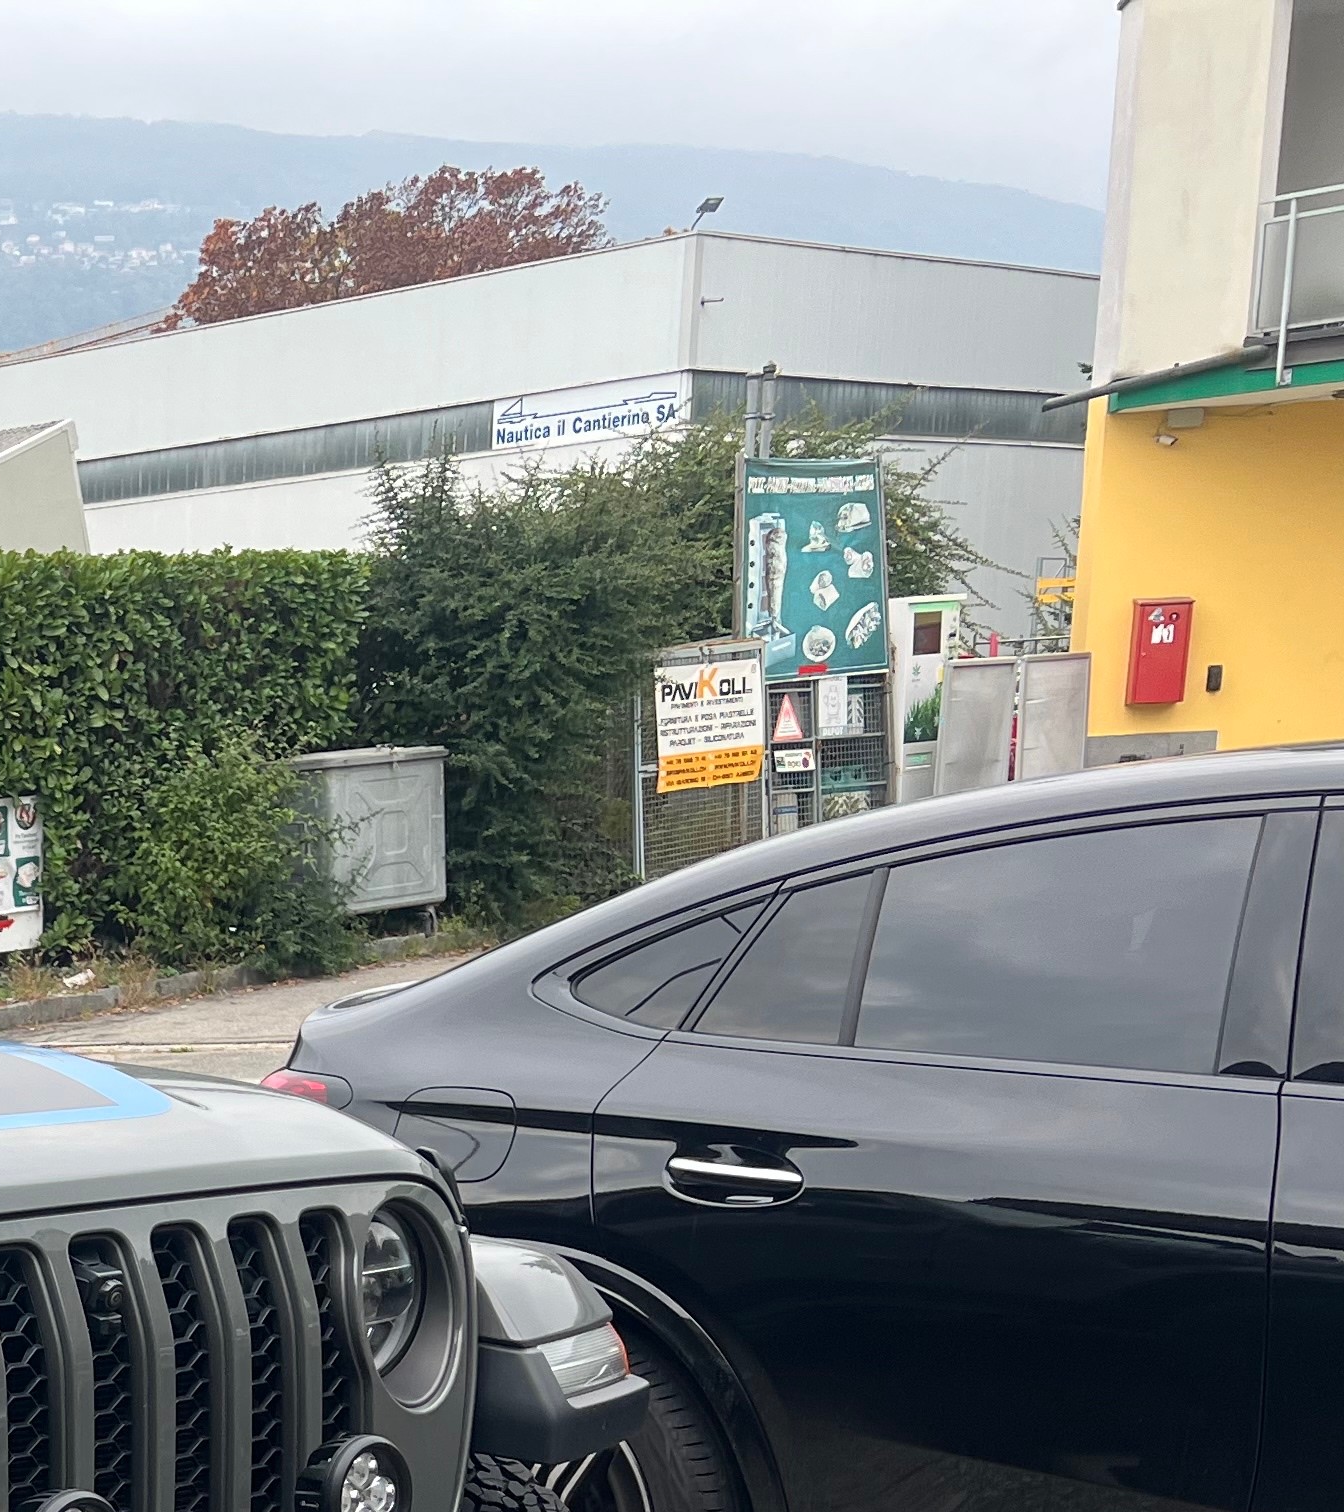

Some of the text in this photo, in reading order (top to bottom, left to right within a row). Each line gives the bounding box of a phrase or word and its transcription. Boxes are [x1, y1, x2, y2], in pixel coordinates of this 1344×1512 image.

[496, 403, 677, 445] Nautica il Cantierino SA
[662, 667, 753, 702] PAVIKOLL
